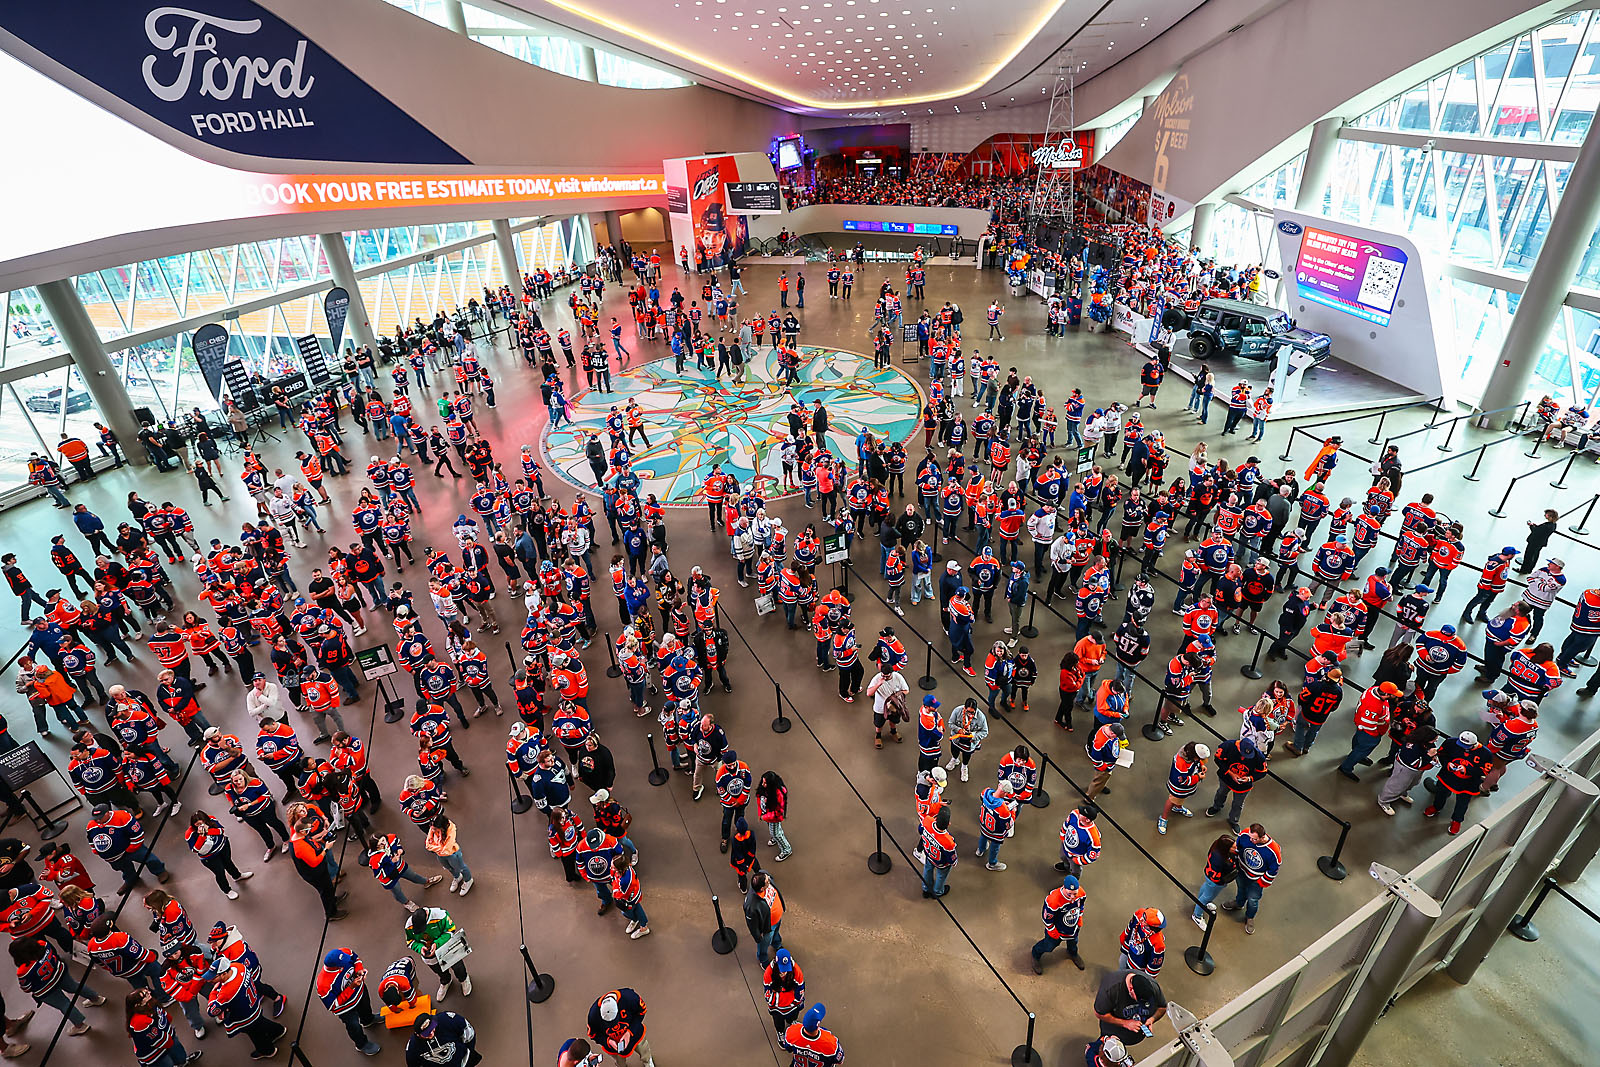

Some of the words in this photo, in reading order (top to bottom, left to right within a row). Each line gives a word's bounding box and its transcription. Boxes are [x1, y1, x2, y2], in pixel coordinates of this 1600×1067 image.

[142, 7, 315, 101] Ford
[1154, 90, 1194, 126] Molson
[191, 112, 256, 136] FORD
[257, 108, 314, 130] HALL
[1170, 131, 1188, 150] BEER
[1032, 146, 1083, 168] Molson
[246, 183, 314, 205] BOOK
[312, 182, 372, 203] YOUR
[375, 180, 424, 200] FREE
[427, 179, 505, 198] ESTIMATE
[506, 178, 553, 196] TODAY,
[554, 177, 580, 194] visit
[581, 176, 657, 192] windowmart.ca
[209, 335, 226, 344] CHED
[592, 357, 603, 366] 94
[284, 381, 304, 393] CHED
[460, 401, 470, 412] 97
[1302, 499, 1320, 514] 97
[1219, 514, 1233, 527] 29
[1404, 512, 1424, 528] 97
[1355, 524, 1367, 541] 18
[1400, 542, 1417, 560] 93
[1403, 606, 1418, 621] 97
[1118, 636, 1139, 656] 97
[1511, 659, 1540, 684] 99
[1519, 656, 1539, 671] GRETZKY
[1310, 697, 1337, 714] 97
[1365, 709, 1377, 718] 97
[1473, 755, 1480, 763] C
[979, 806, 995, 831] 18
[922, 835, 941, 861] 29
[620, 1010, 627, 1018] C
[796, 1048, 820, 1060] McDAVID
